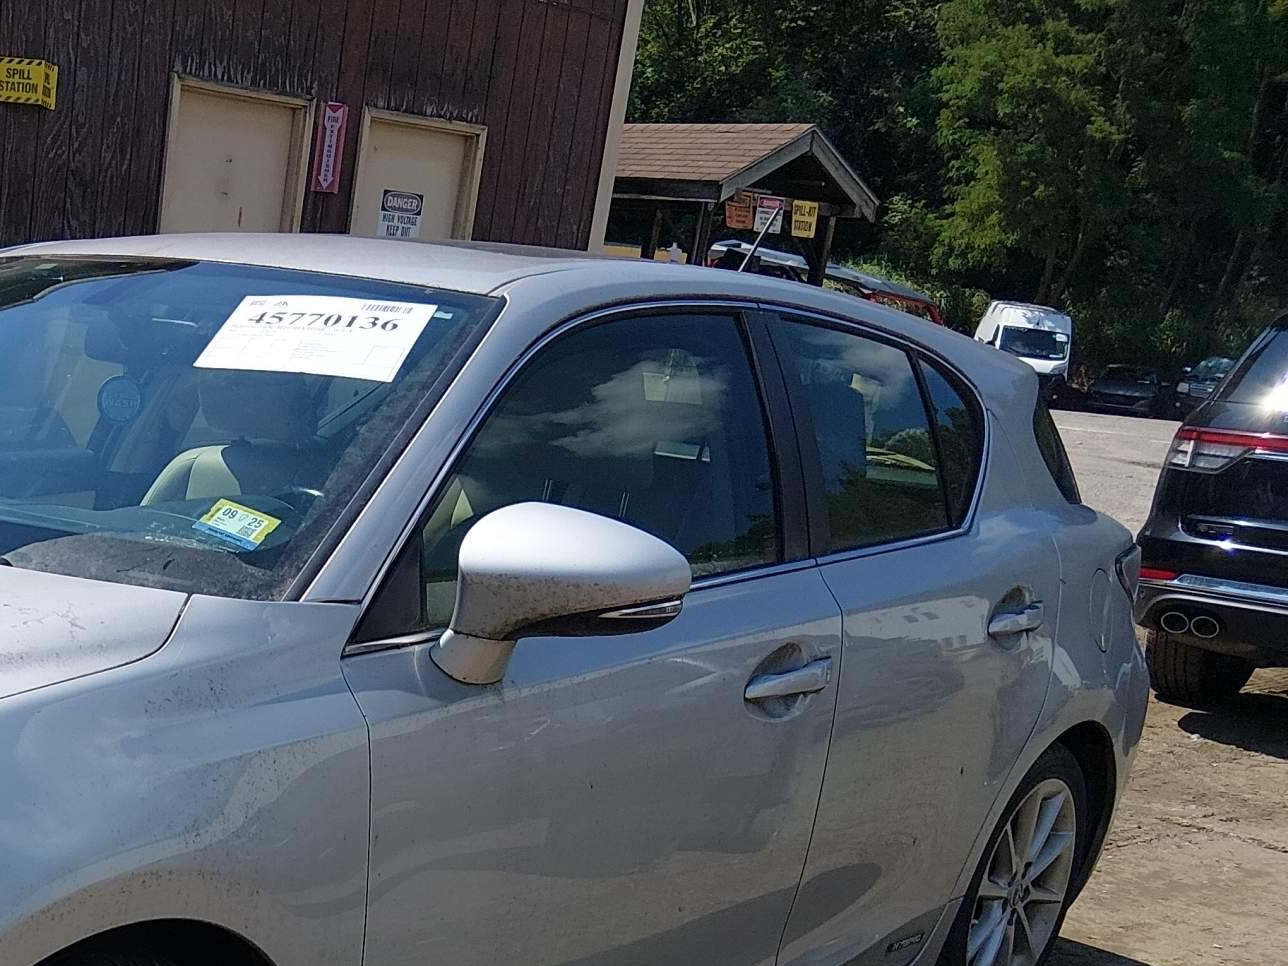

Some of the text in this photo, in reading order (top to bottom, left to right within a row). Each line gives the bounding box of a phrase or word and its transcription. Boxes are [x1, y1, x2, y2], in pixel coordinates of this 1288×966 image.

[6, 68, 32, 80] SPILL
[387, 196, 418, 210] DANGER
[248, 311, 402, 332] 45770136
[222, 507, 239, 519] 09
[247, 517, 265, 529] 25
